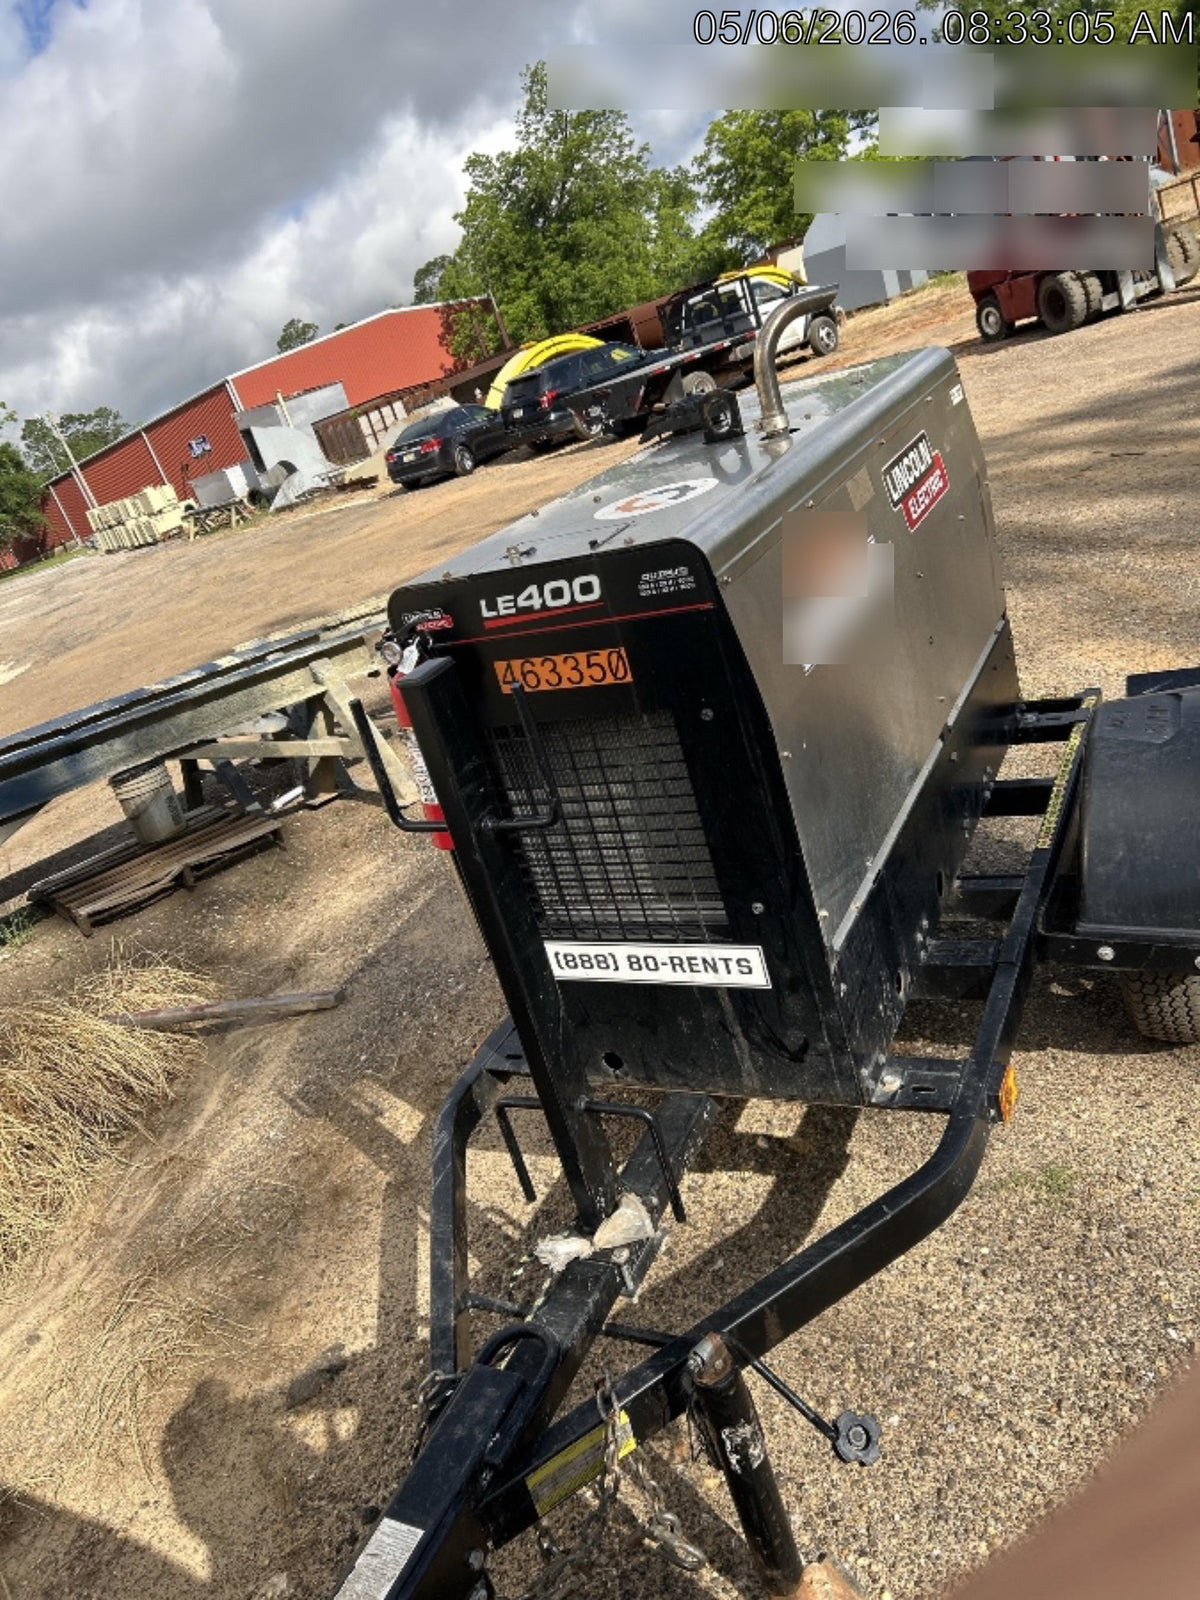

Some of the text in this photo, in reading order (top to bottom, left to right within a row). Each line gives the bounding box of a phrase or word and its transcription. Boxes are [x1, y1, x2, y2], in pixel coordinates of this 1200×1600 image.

[886, 438, 932, 502] LINCOLN
[479, 574, 601, 618] LE400
[502, 649, 629, 689] 463350
[554, 951, 753, 976] (888) 80-RENTS
